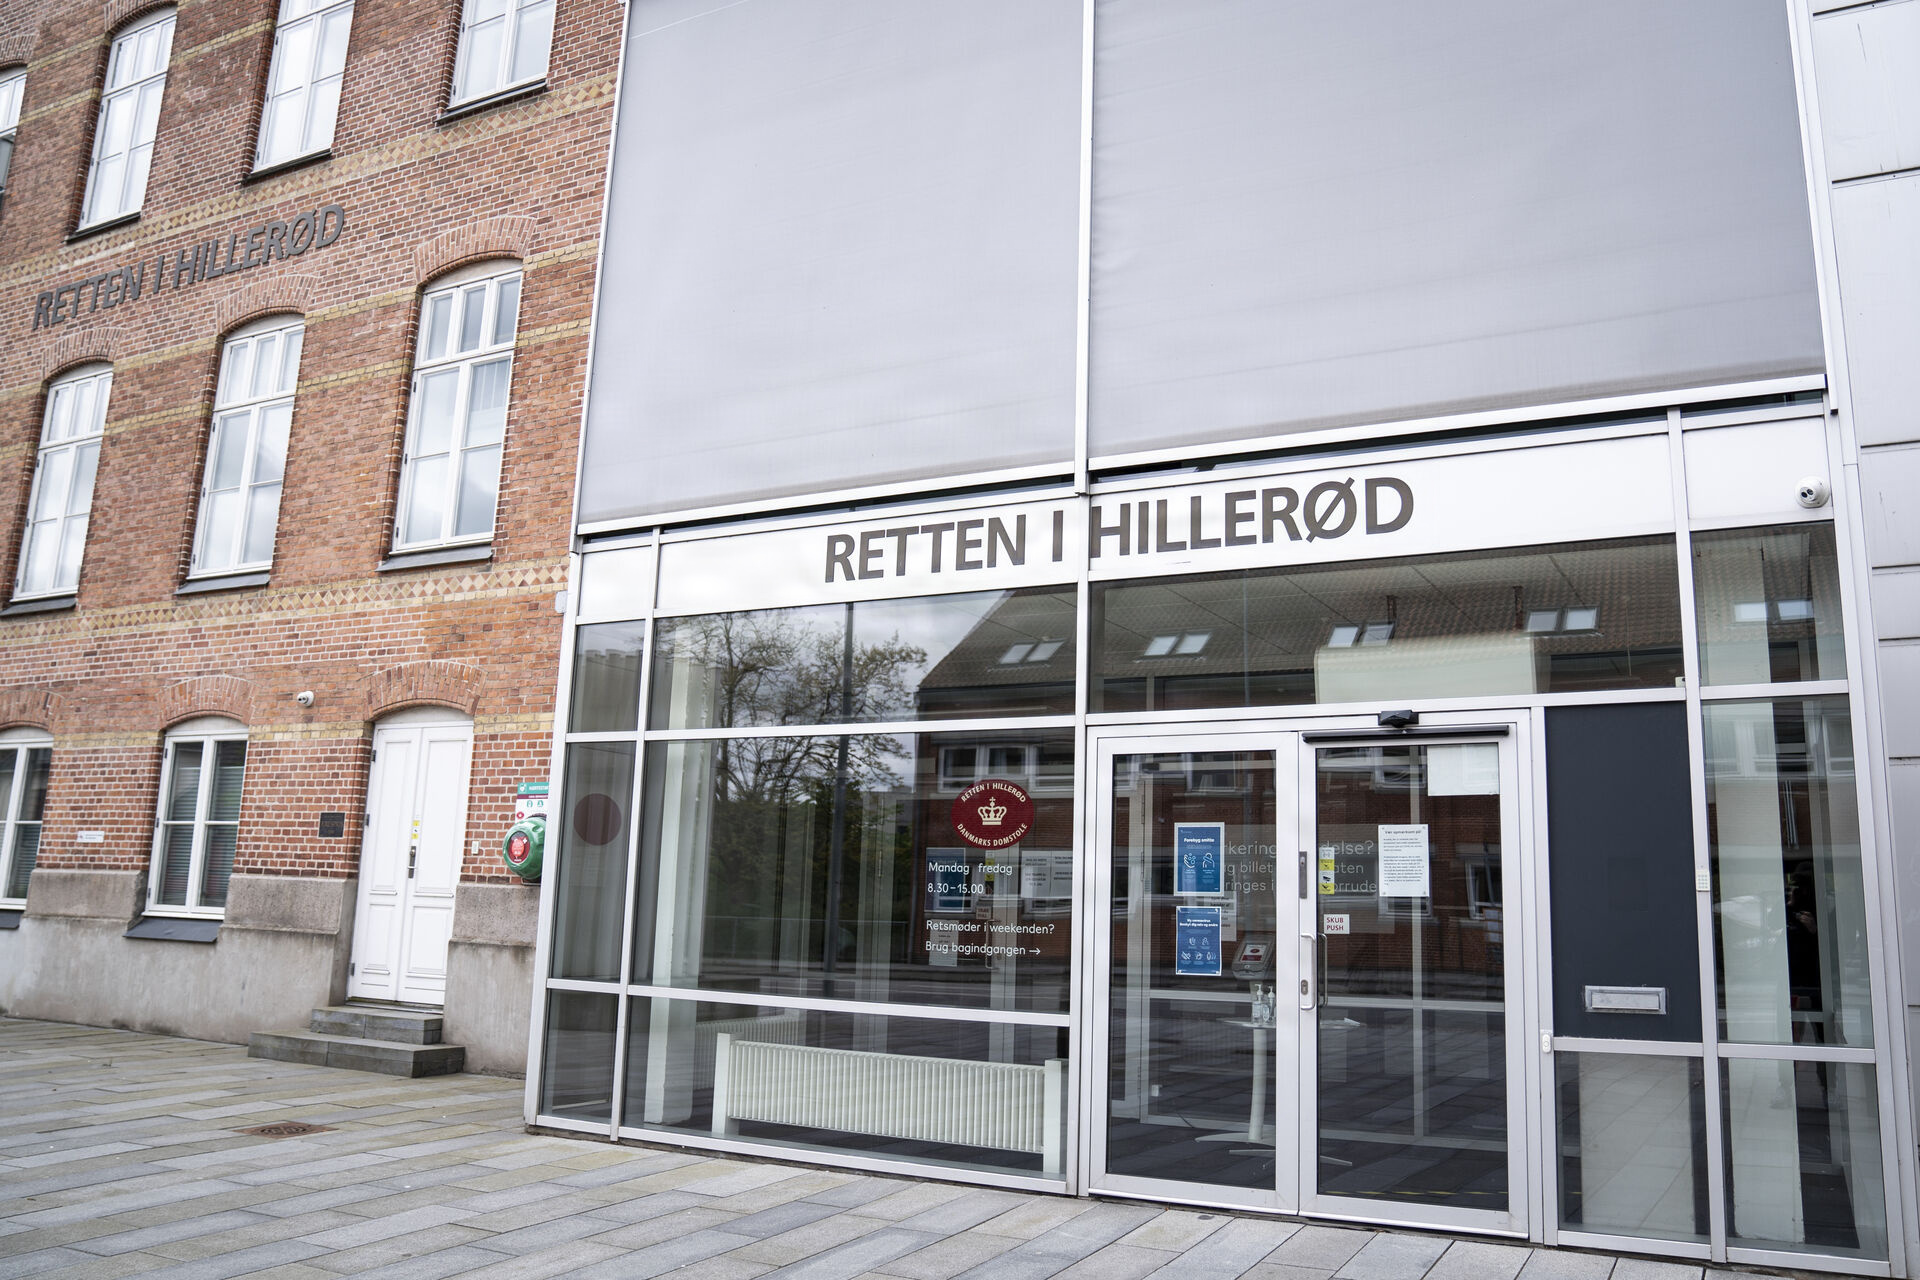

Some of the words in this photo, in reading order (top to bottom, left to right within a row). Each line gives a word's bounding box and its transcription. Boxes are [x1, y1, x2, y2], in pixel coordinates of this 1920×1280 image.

[32, 261, 145, 330] RETTEN
[152, 255, 165, 294] I
[172, 204, 345, 288] HILLERØD
[824, 514, 1027, 584] RETTEN
[1051, 510, 1064, 563] I
[1090, 477, 1415, 559] HILLERØD
[961, 783, 985, 803] RETTEN
[992, 782, 1026, 803] HILLERØD
[957, 823, 991, 847] DANMARKS
[993, 822, 1028, 847] DOMSTOLE
[928, 862, 970, 875] Mandag
[978, 862, 1013, 875] fredag
[926, 920, 982, 932] Retsmøder
[983, 922, 987, 932] i
[989, 922, 1055, 934] weekenden?
[925, 941, 949, 954] Brug
[951, 942, 1026, 957] bagindgangen
